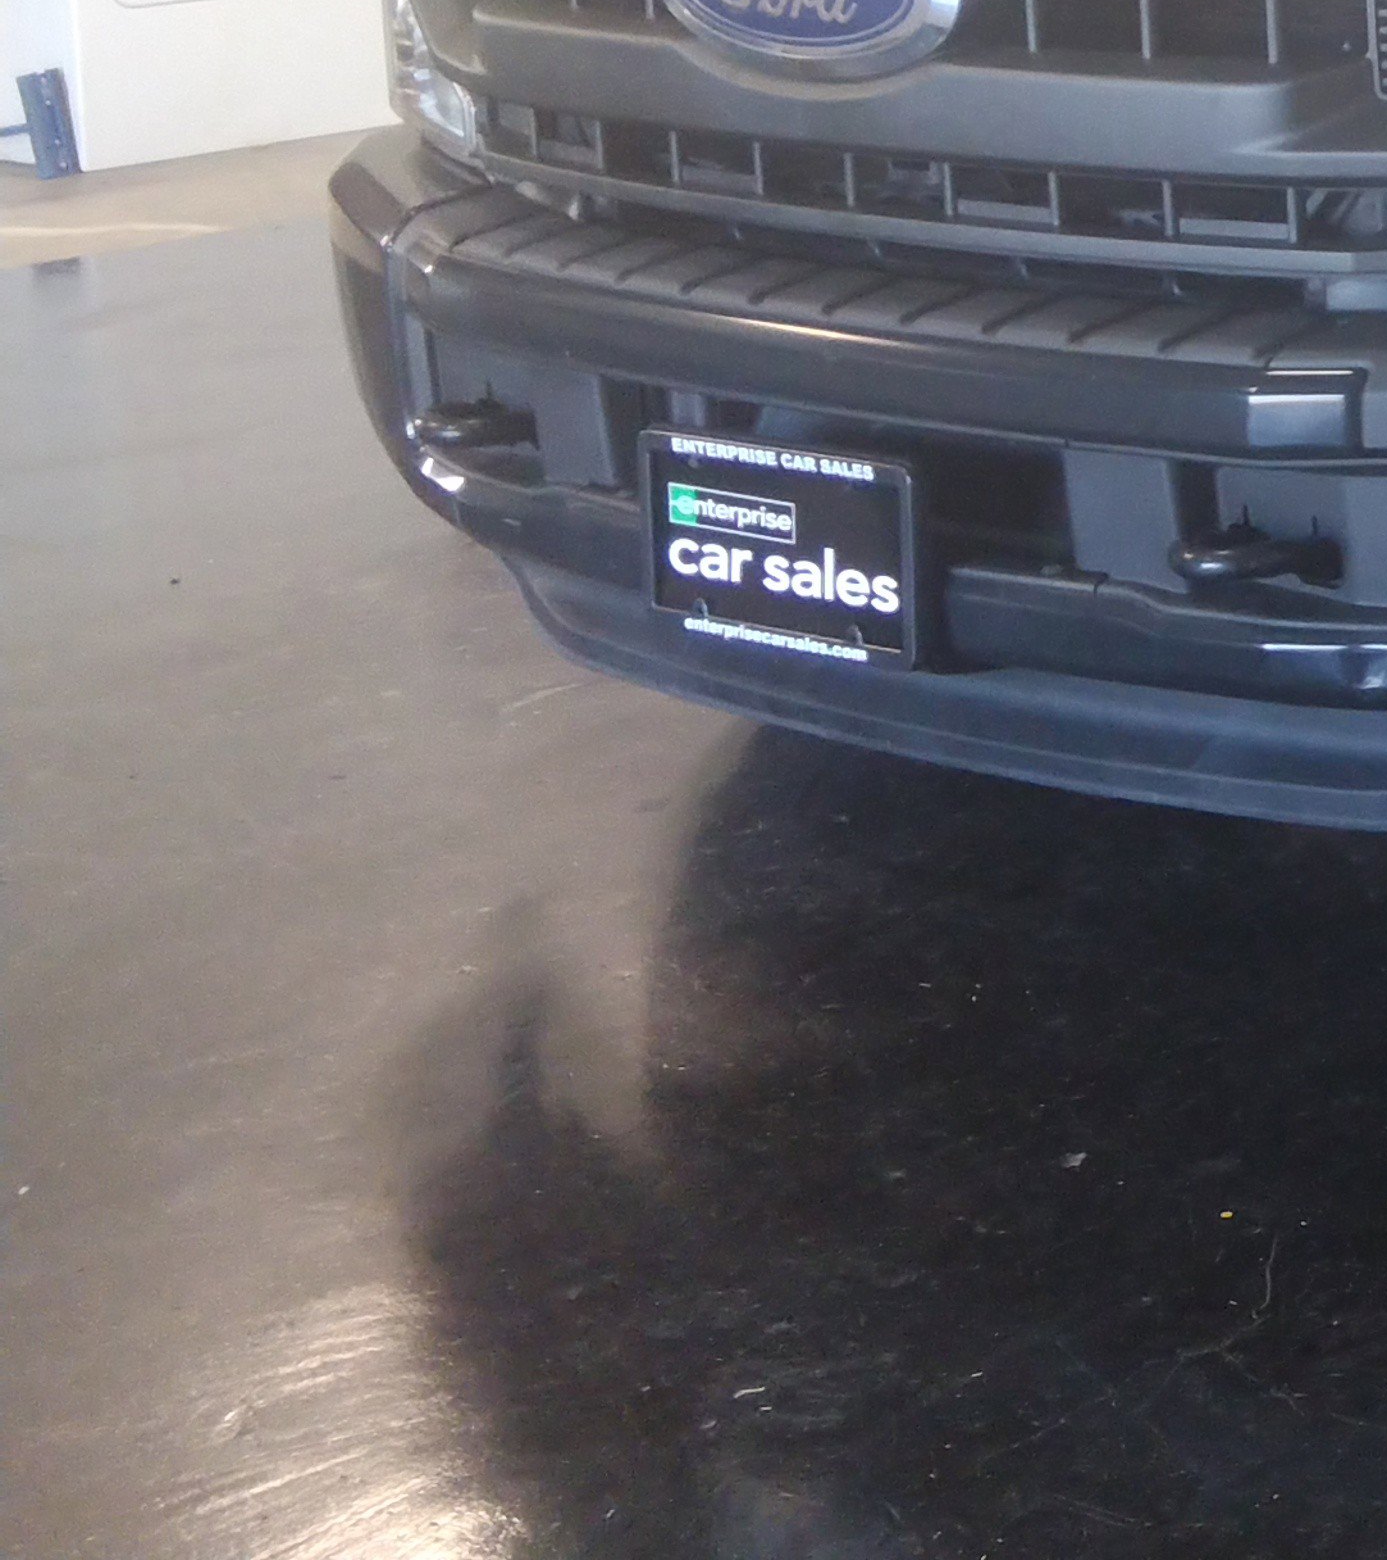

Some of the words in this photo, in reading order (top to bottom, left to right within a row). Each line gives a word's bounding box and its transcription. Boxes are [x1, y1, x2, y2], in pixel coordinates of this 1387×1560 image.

[671, 437, 778, 467] ENTERPRISE
[779, 453, 818, 474] CAR
[819, 459, 875, 482] SALES
[677, 495, 792, 531] enterprise
[668, 538, 753, 584] car
[762, 547, 899, 613] sales
[684, 617, 869, 663] enterprisecarsales.com
